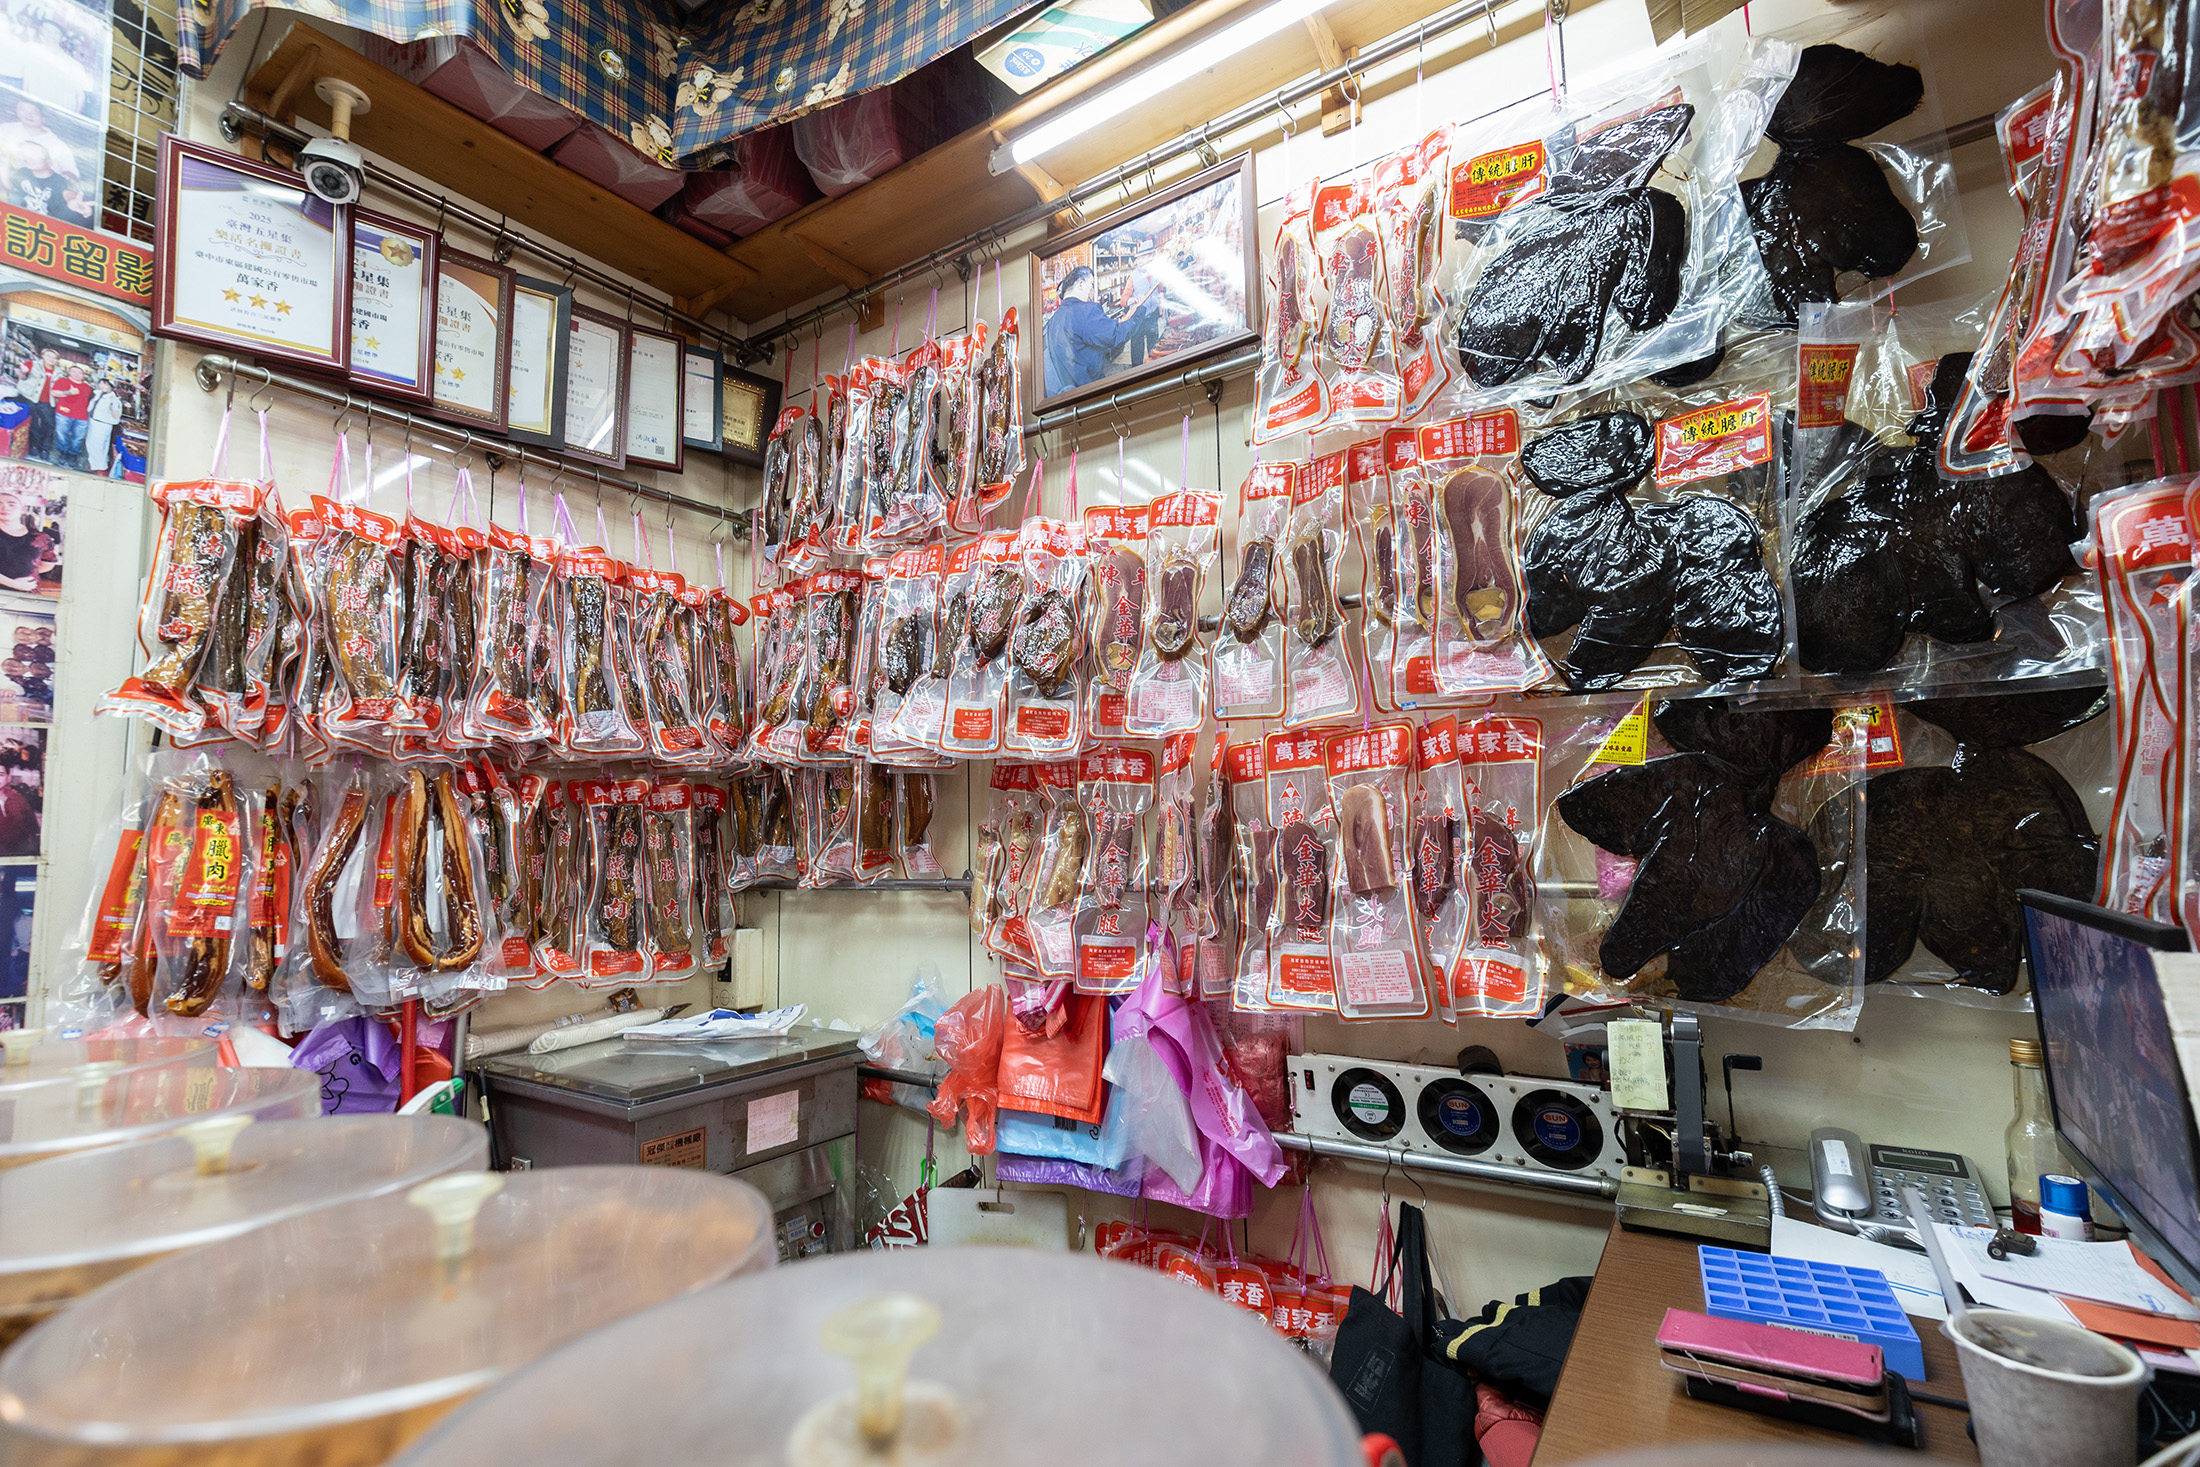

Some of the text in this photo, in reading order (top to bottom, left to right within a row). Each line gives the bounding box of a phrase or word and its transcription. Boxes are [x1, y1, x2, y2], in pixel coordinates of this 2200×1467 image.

[249, 212, 272, 225] 2025
[0, 213, 153, 296] 訪留影
[236, 273, 279, 292] 萬家香
[1682, 410, 1757, 442] 傳統膽肝
[1094, 515, 1148, 534] 萬家香
[2135, 515, 2190, 549] 萬
[1032, 528, 1086, 551] 萬家香
[631, 573, 677, 594] 萬家香
[1111, 596, 1140, 690] 金華火腿
[1275, 739, 1318, 761] 萬家
[1422, 730, 1453, 761] 家香
[1457, 730, 1528, 756] 萬家香
[1087, 757, 1146, 776] 萬家香
[592, 783, 642, 805] 萬家香
[202, 815, 225, 835] 廣東
[206, 840, 229, 880] 臘肉
[603, 856, 628, 921] 臘肉
[659, 859, 681, 919] 臘肉
[1096, 842, 1129, 935] 金華火腿
[1292, 834, 1324, 942] 金華火腿
[1474, 837, 1510, 949] 金華火腿
[1448, 1100, 1469, 1109] SUN
[1544, 1113, 1566, 1123] SUN
[674, 1132, 702, 1147] 機械廠
[1223, 1280, 1265, 1308] 家香
[1272, 1305, 1336, 1333] 萬家香
